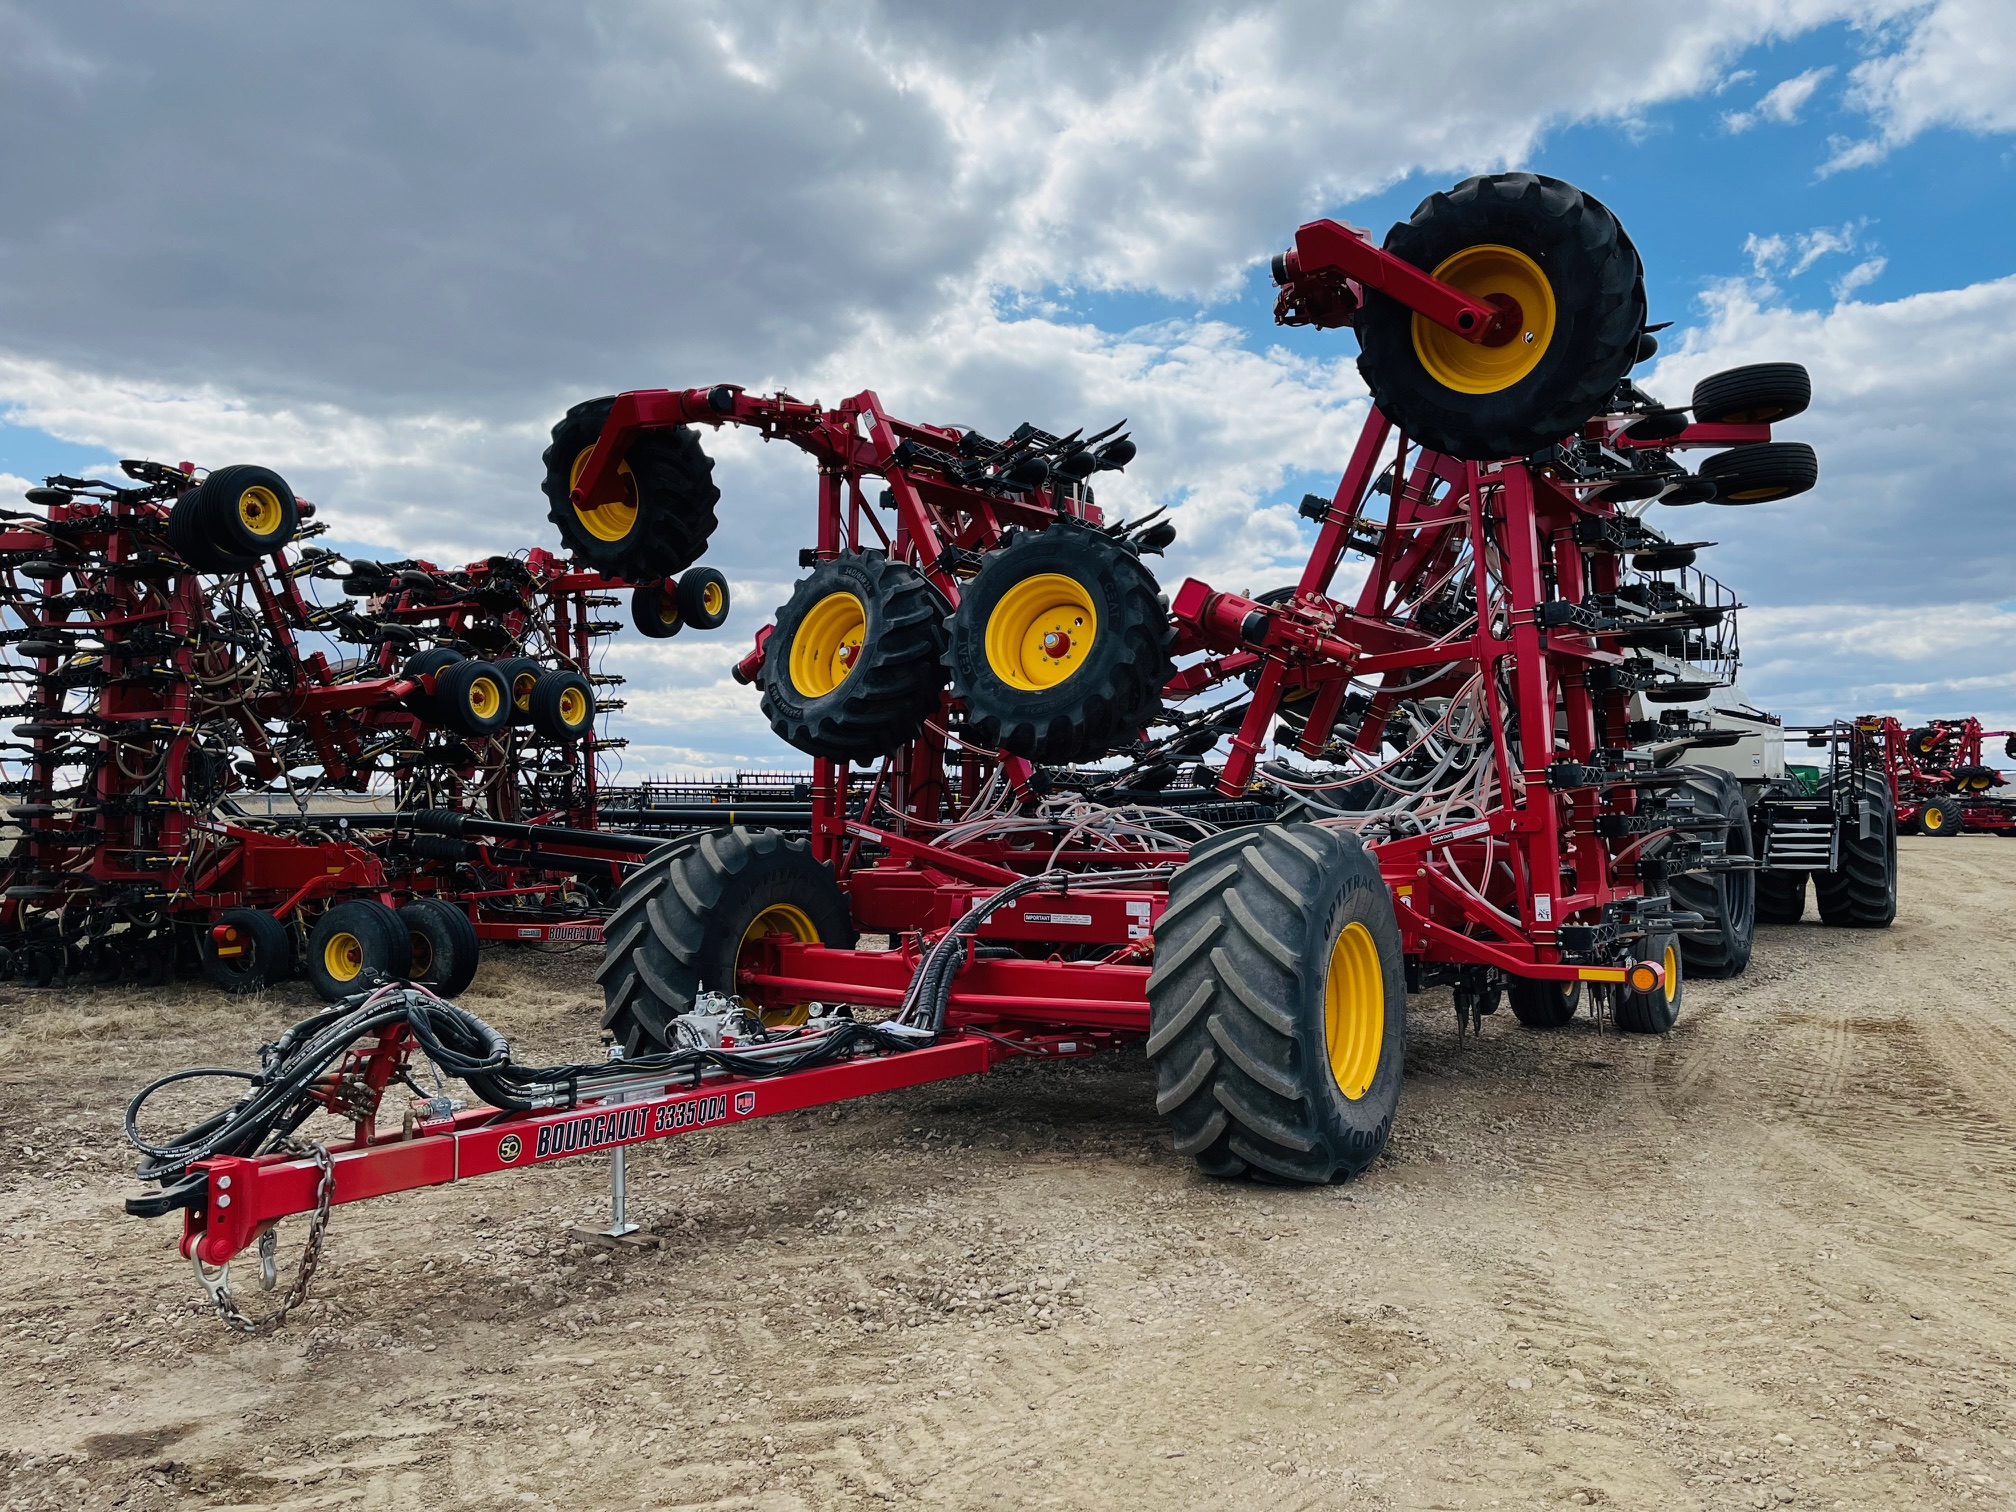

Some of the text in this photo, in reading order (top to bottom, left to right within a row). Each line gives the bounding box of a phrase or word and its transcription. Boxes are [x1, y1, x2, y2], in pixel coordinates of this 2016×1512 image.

[1323, 873, 1376, 942] OPTITRAC
[1025, 914, 1051, 923] IMPORTANT
[548, 926, 602, 942] BOURGAULT
[535, 1107, 650, 1158] BOURGAULT
[500, 1141, 519, 1159] 50
